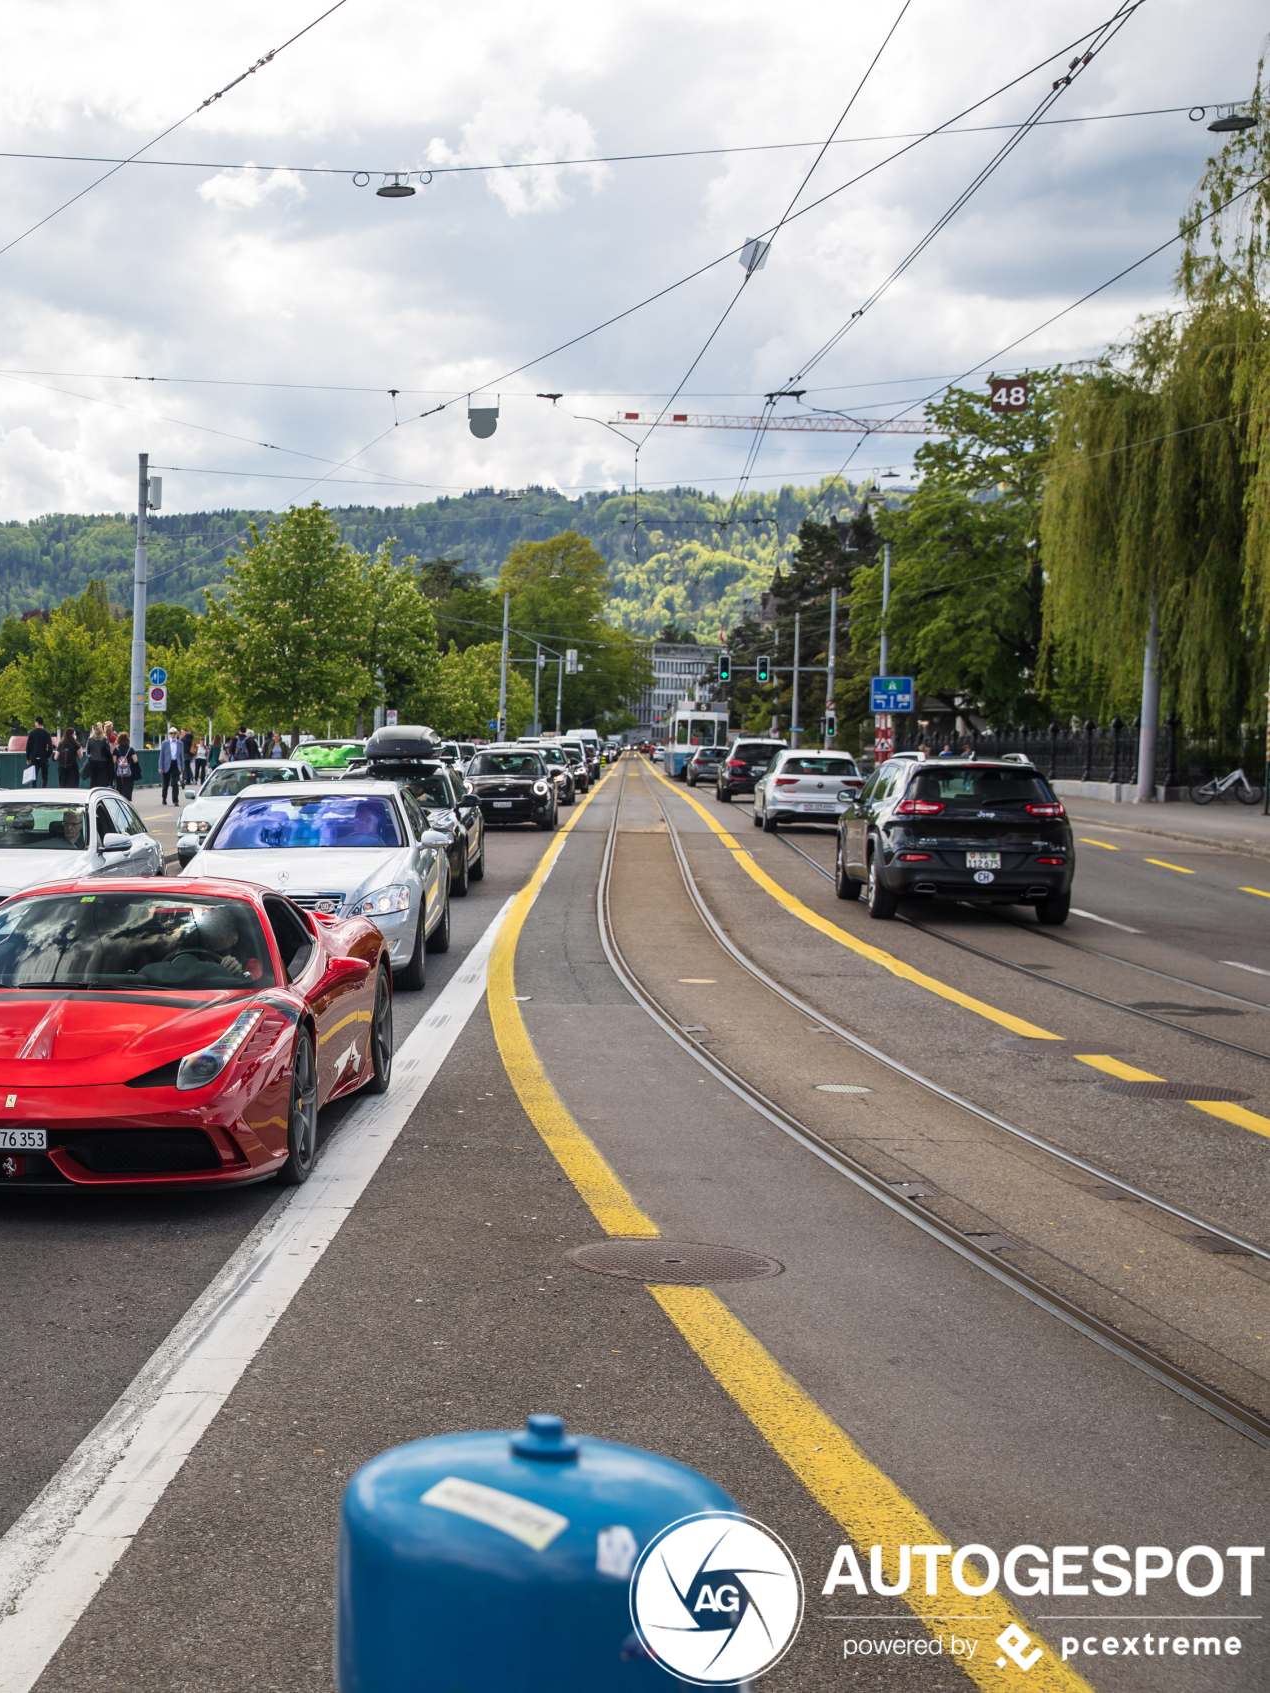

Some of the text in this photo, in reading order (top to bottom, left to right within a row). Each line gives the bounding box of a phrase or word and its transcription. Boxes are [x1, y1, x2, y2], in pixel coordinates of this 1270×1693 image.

[992, 386, 1026, 406] 48
[700, 703, 708, 712] 5
[976, 811, 996, 819] Jeep
[977, 872, 990, 882] CH
